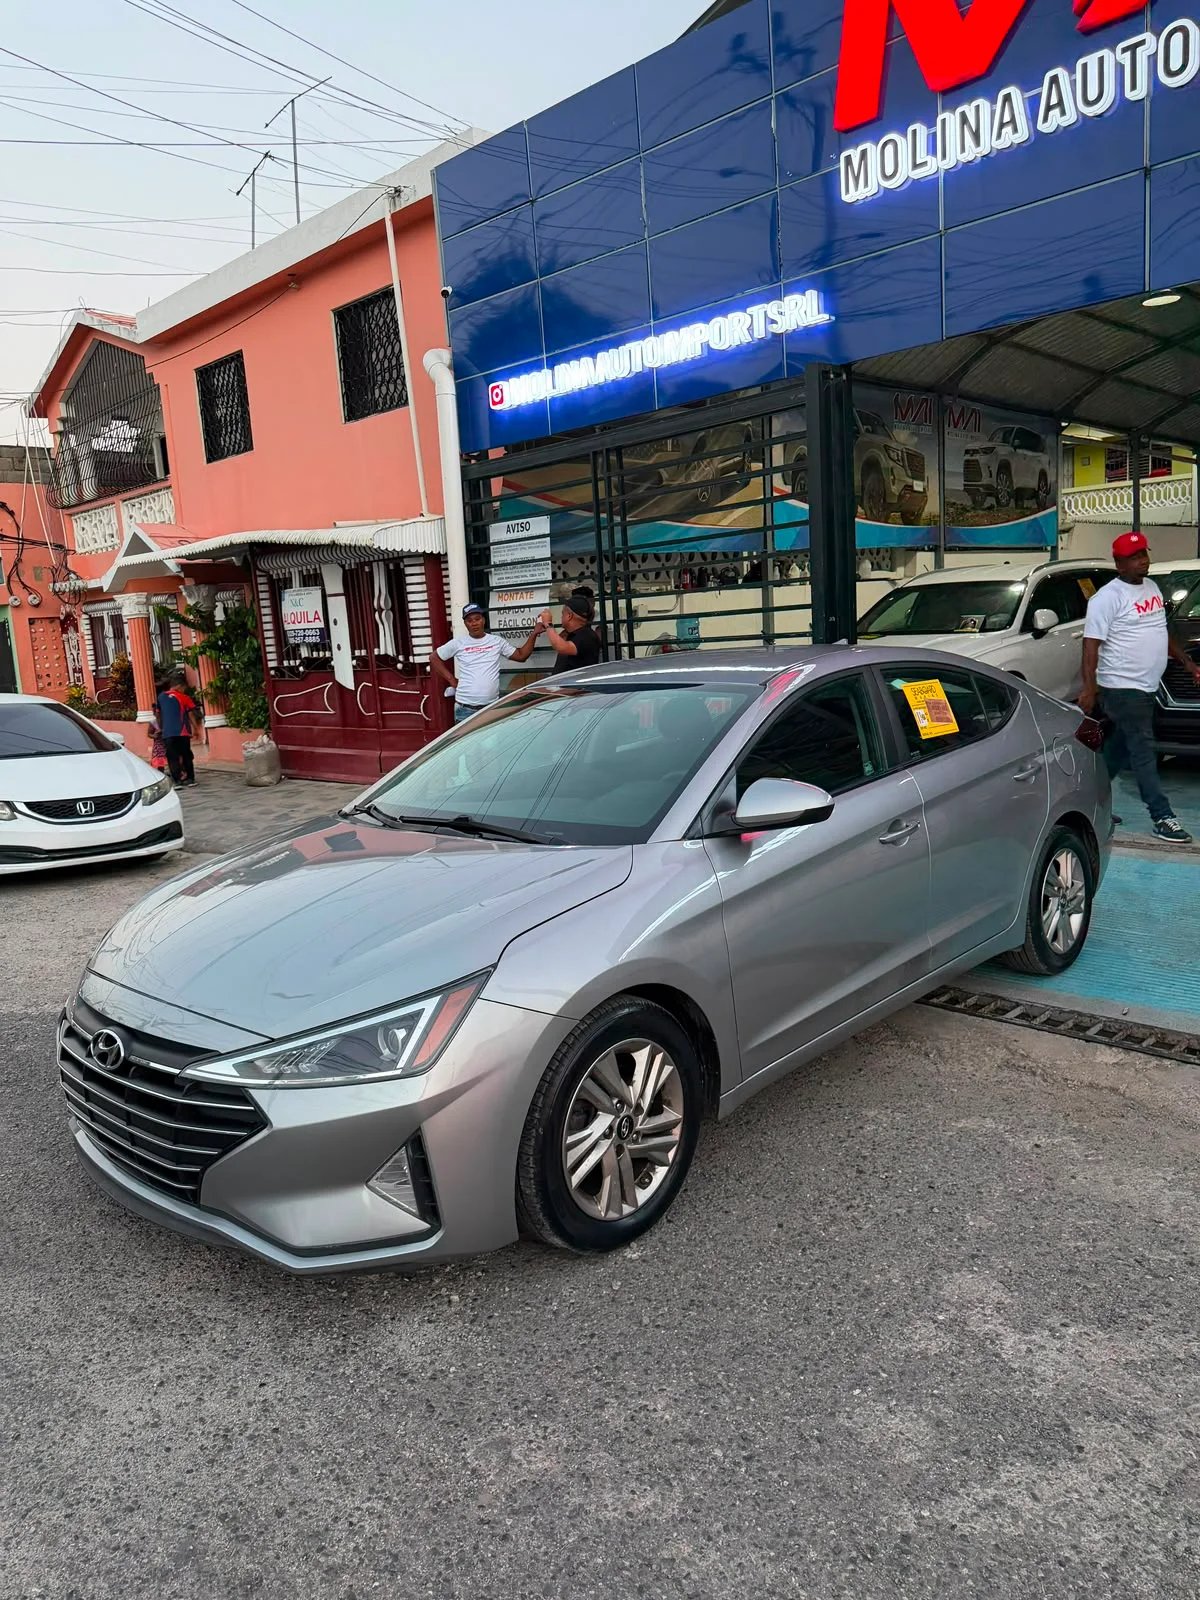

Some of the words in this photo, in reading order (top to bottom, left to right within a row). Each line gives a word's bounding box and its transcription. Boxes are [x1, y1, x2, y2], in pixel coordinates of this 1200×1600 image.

[840, 86, 1031, 204] MOLINA
[1037, 17, 1200, 134] AUTO
[505, 520, 531, 534] AVISO
[498, 617, 520, 629] FÁCIL
[521, 617, 538, 627] CON
[500, 629, 541, 640] NOSOTR
